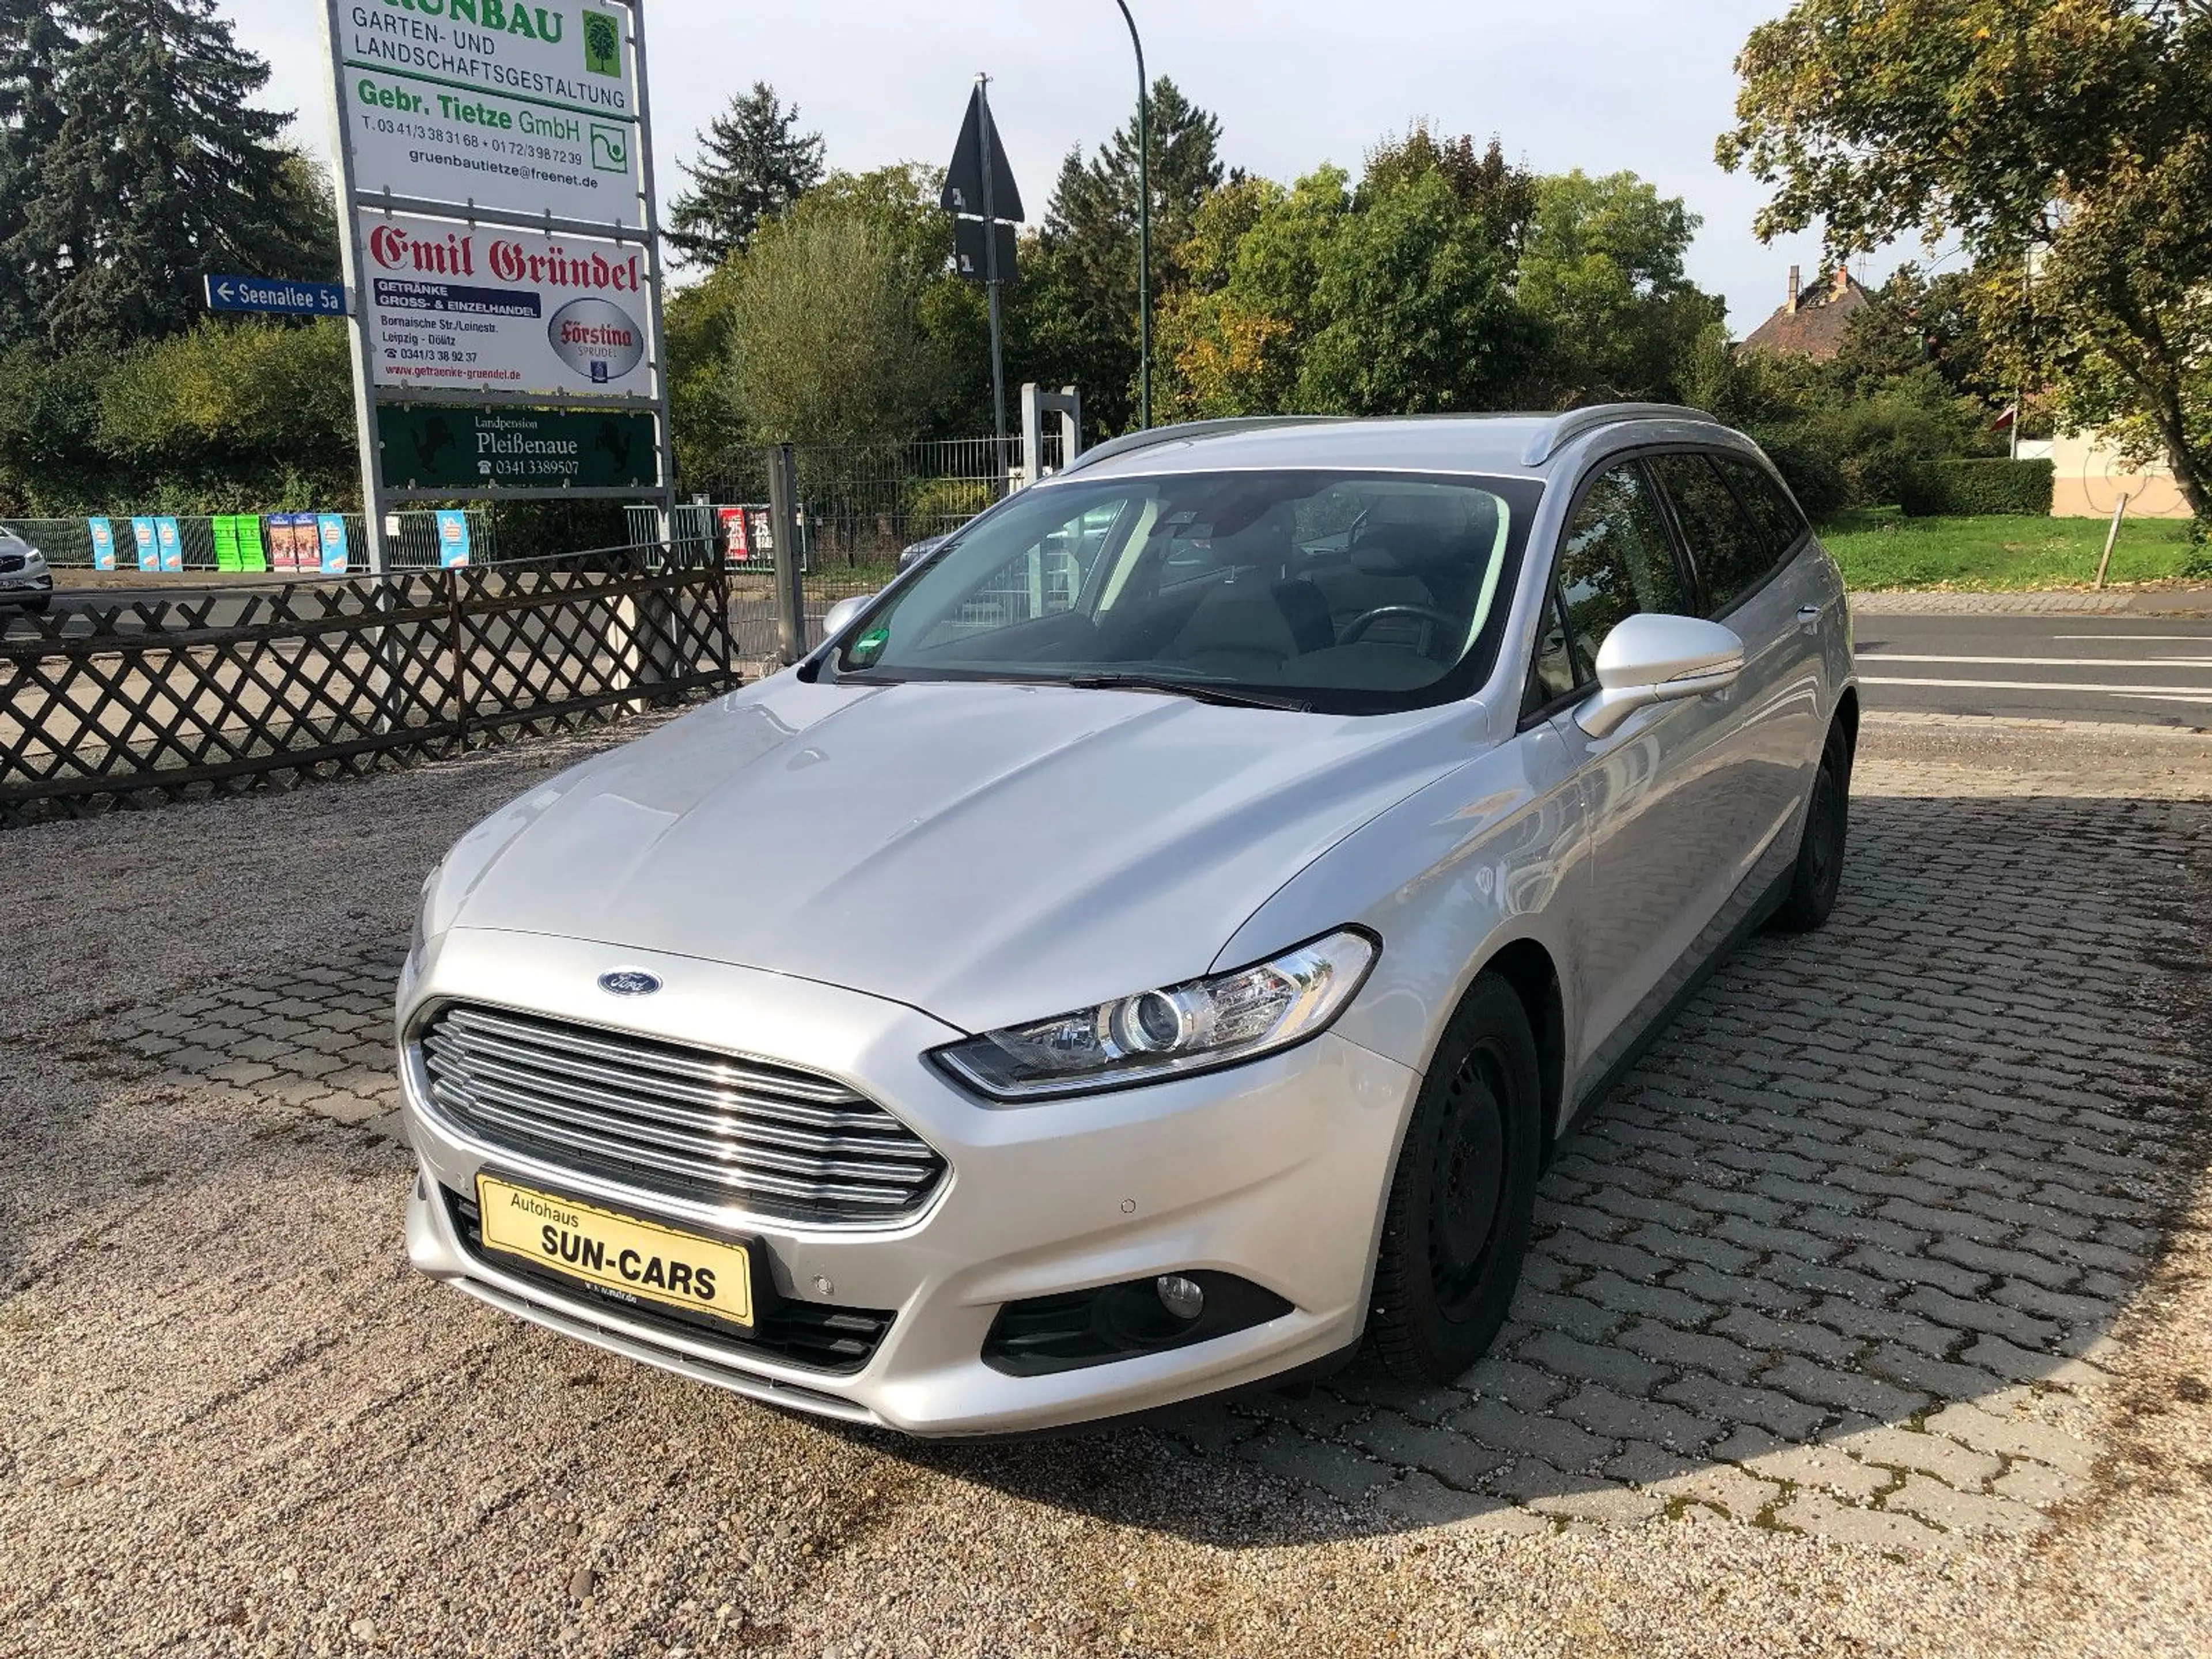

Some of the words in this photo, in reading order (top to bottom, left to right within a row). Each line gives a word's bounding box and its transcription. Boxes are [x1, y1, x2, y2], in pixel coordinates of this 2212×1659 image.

[352, 6, 446, 43] GARTEN-
[453, 29, 495, 55] UND
[355, 33, 625, 109] LANDSCHAFTSGESTALTUNG
[358, 78, 430, 115] Gebr.
[437, 94, 512, 130] Tietze
[519, 110, 580, 142] GmbH
[409, 150, 598, 188] gruenbautietze@freenet.de
[370, 225, 475, 276] Emil
[489, 240, 639, 293] Gründel
[238, 283, 313, 308] Seenallee
[320, 289, 339, 309] 5a
[378, 281, 448, 296] GETRÄNKE
[380, 295, 431, 308] GROSS-
[434, 300, 444, 309] &
[448, 301, 537, 317] EINZELHANDEL
[382, 331, 418, 346] Leipzig
[560, 319, 632, 346] Förstina
[577, 346, 618, 358] SPRUDEL
[385, 365, 521, 380] www.getraenke-gruendel.de
[475, 416, 538, 430] Landpension
[475, 432, 578, 454] Pleißenaue
[610, 974, 649, 991] Ford
[510, 1192, 579, 1228] Autohaus
[541, 1225, 717, 1300] SUN-CARS
